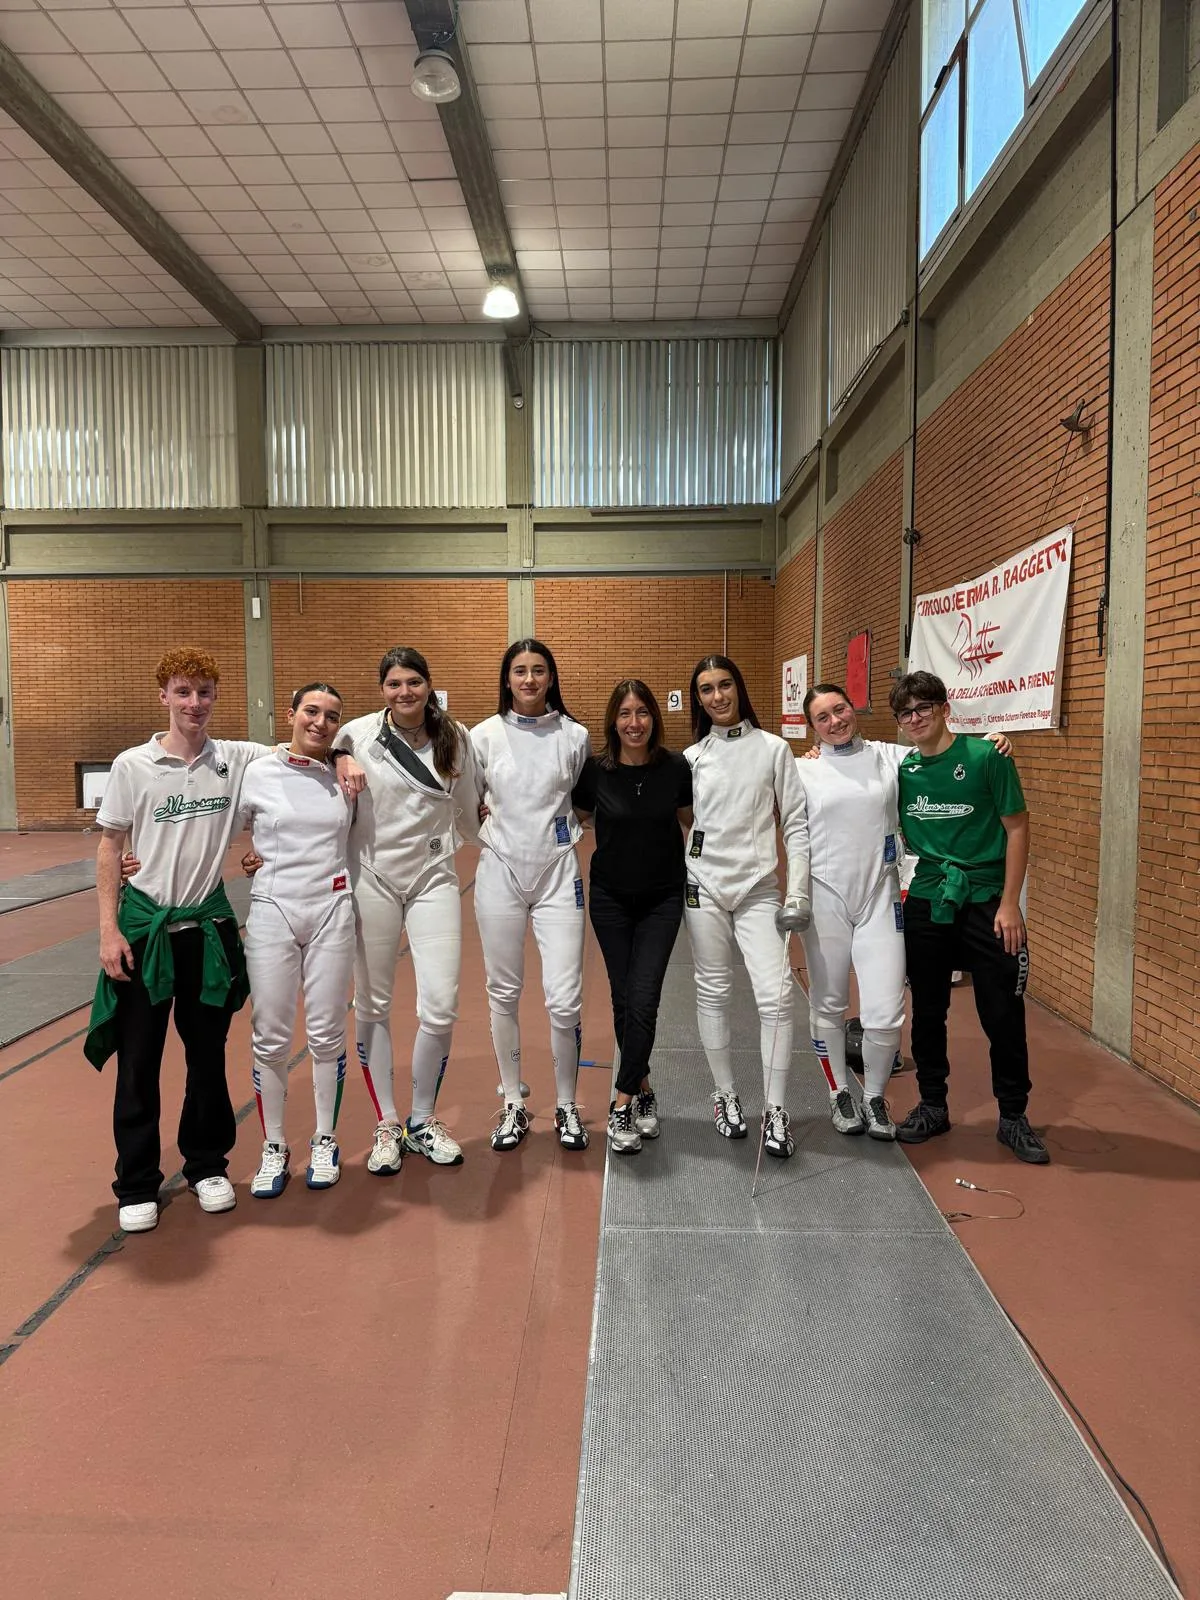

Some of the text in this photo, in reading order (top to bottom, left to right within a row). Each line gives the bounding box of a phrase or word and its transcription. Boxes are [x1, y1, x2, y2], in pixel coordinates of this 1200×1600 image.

[992, 575, 1001, 597] R.
[1003, 538, 1067, 590] RAGGETTI
[955, 687, 977, 699] DELLA
[977, 679, 1017, 697] SCHERMA
[1019, 677, 1026, 691] A
[1027, 670, 1055, 689] FIRENZ
[670, 694, 679, 707] 9
[987, 713, 1004, 723] Circolo
[154, 794, 197, 816] Mens
[907, 796, 964, 812] Mens sana
